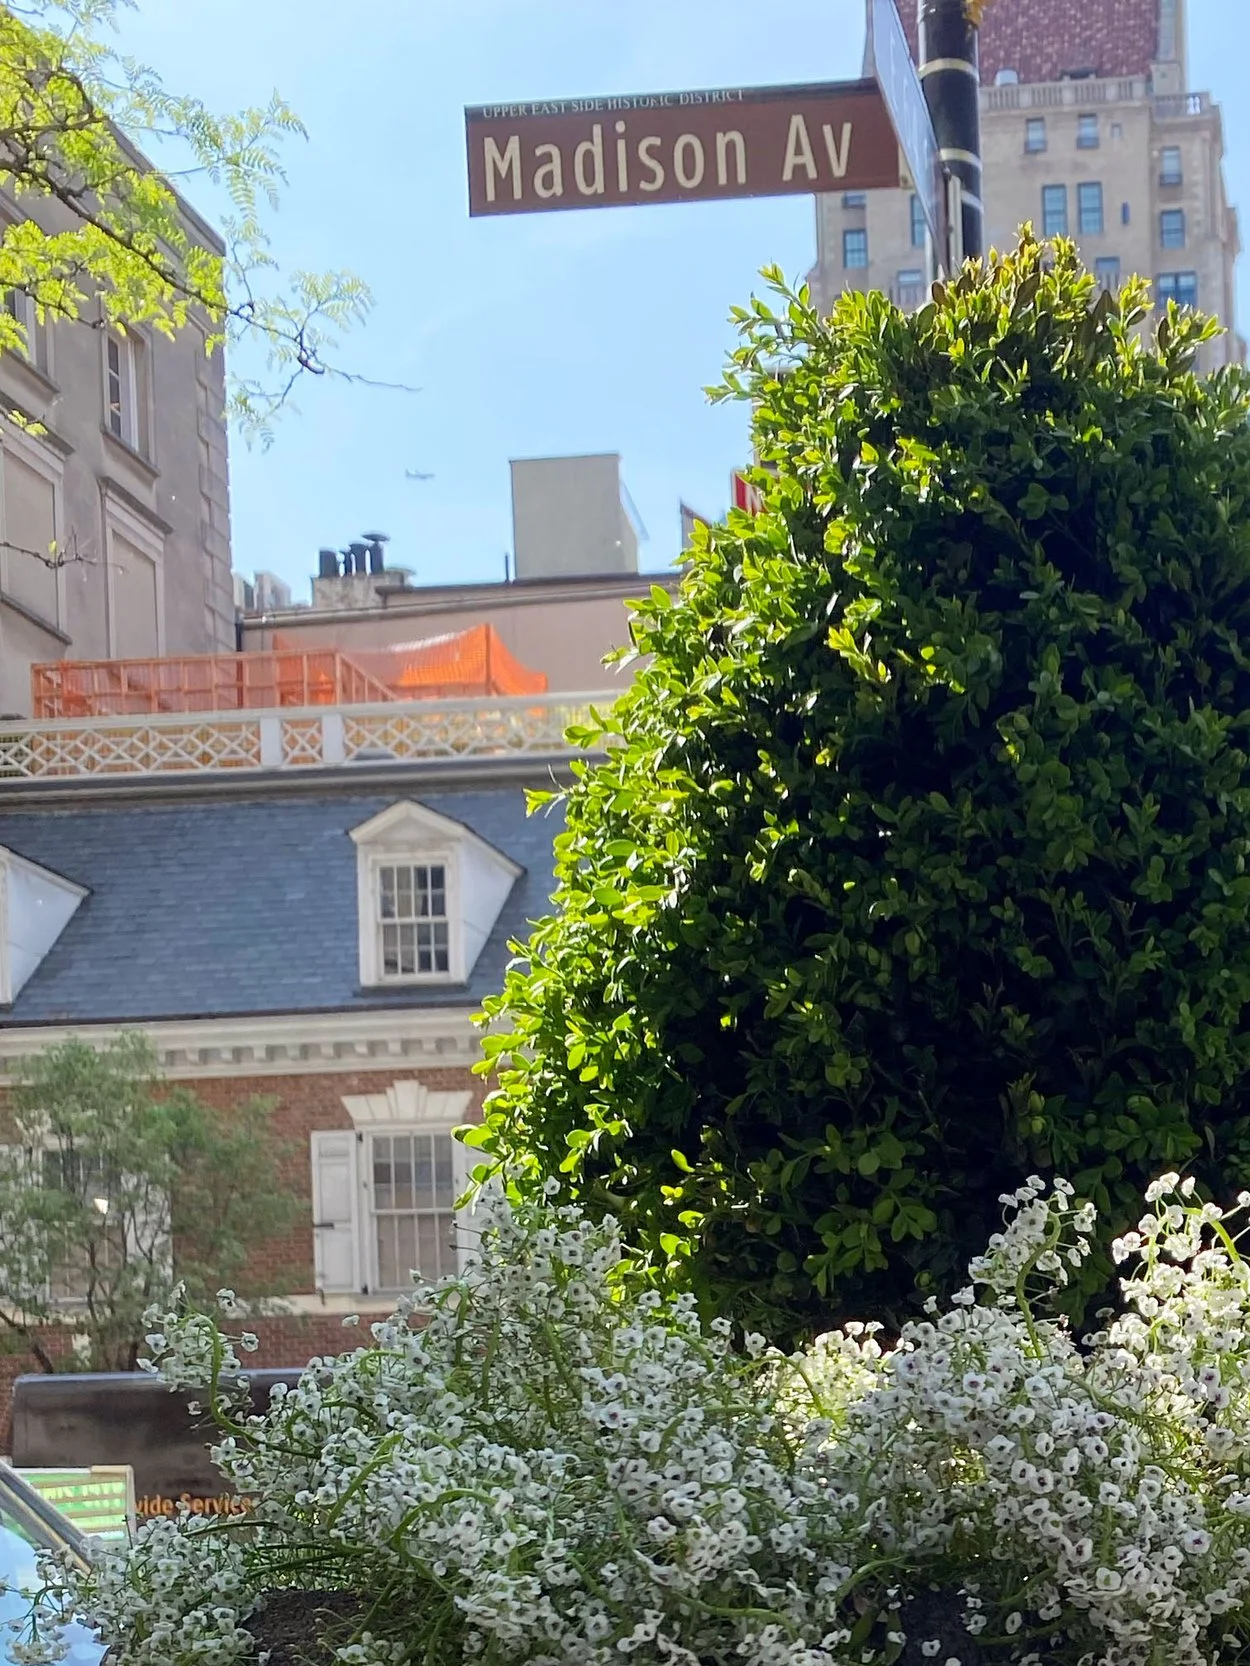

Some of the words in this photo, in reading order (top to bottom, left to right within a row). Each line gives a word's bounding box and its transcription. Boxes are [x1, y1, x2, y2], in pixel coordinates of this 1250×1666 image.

[483, 104, 528, 119] UPPER
[531, 101, 568, 116] EAST
[571, 97, 604, 112] SIDE
[607, 92, 674, 110] HISTORIC
[678, 89, 745, 105] DISTRICT
[483, 120, 747, 202] Madison
[782, 113, 853, 182] Av
